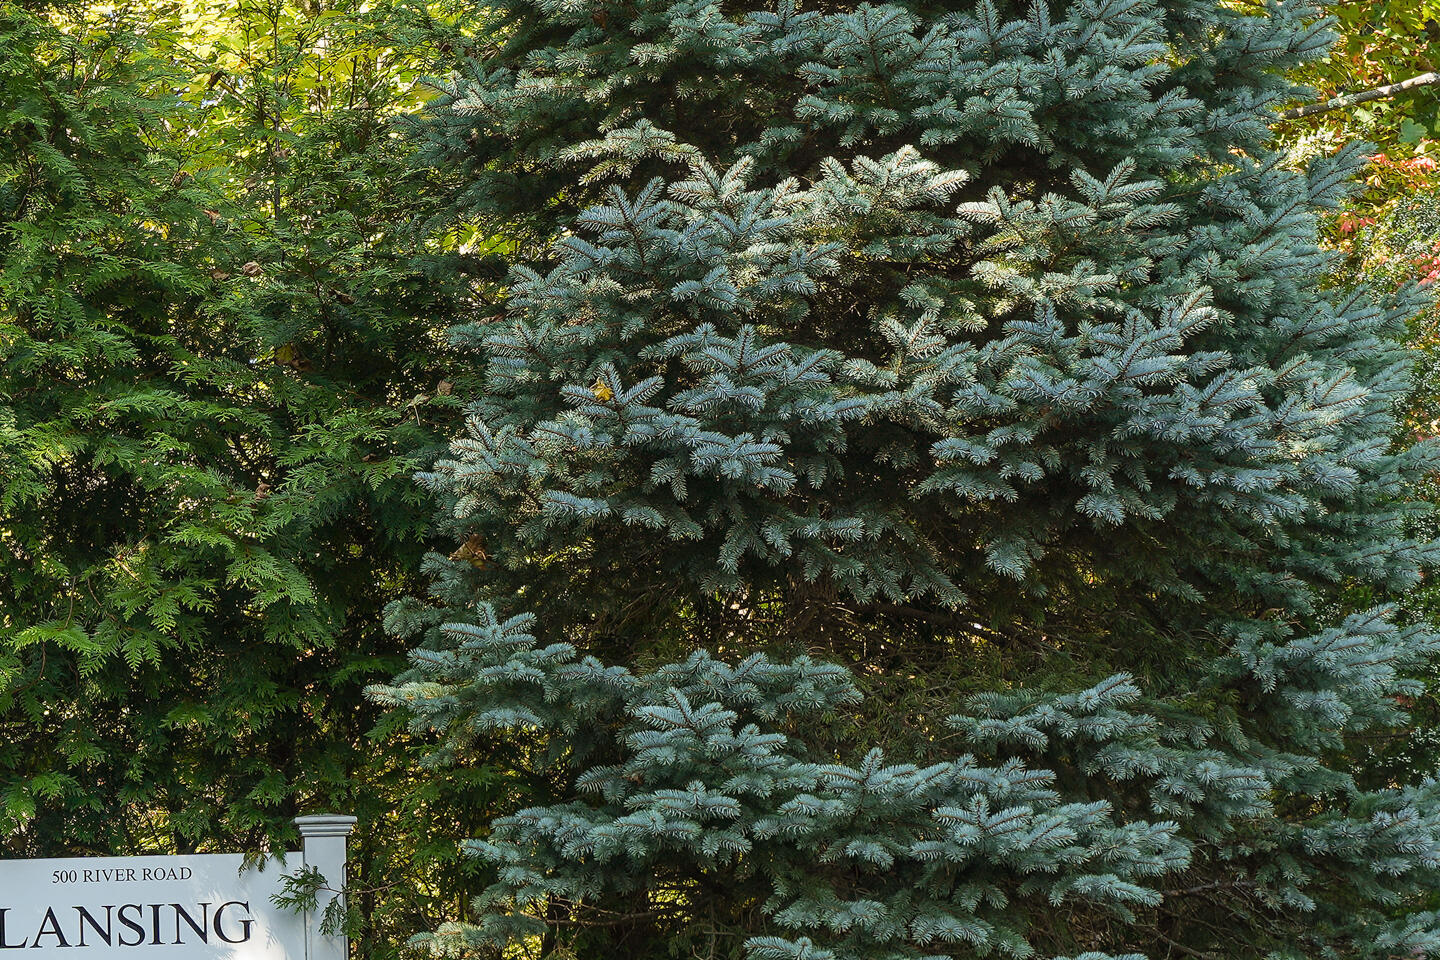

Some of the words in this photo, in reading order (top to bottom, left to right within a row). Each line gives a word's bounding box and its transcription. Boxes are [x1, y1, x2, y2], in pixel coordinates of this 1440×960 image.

[52, 869, 78, 884] 500
[82, 868, 137, 883] RIVER
[142, 867, 193, 881] ROAD
